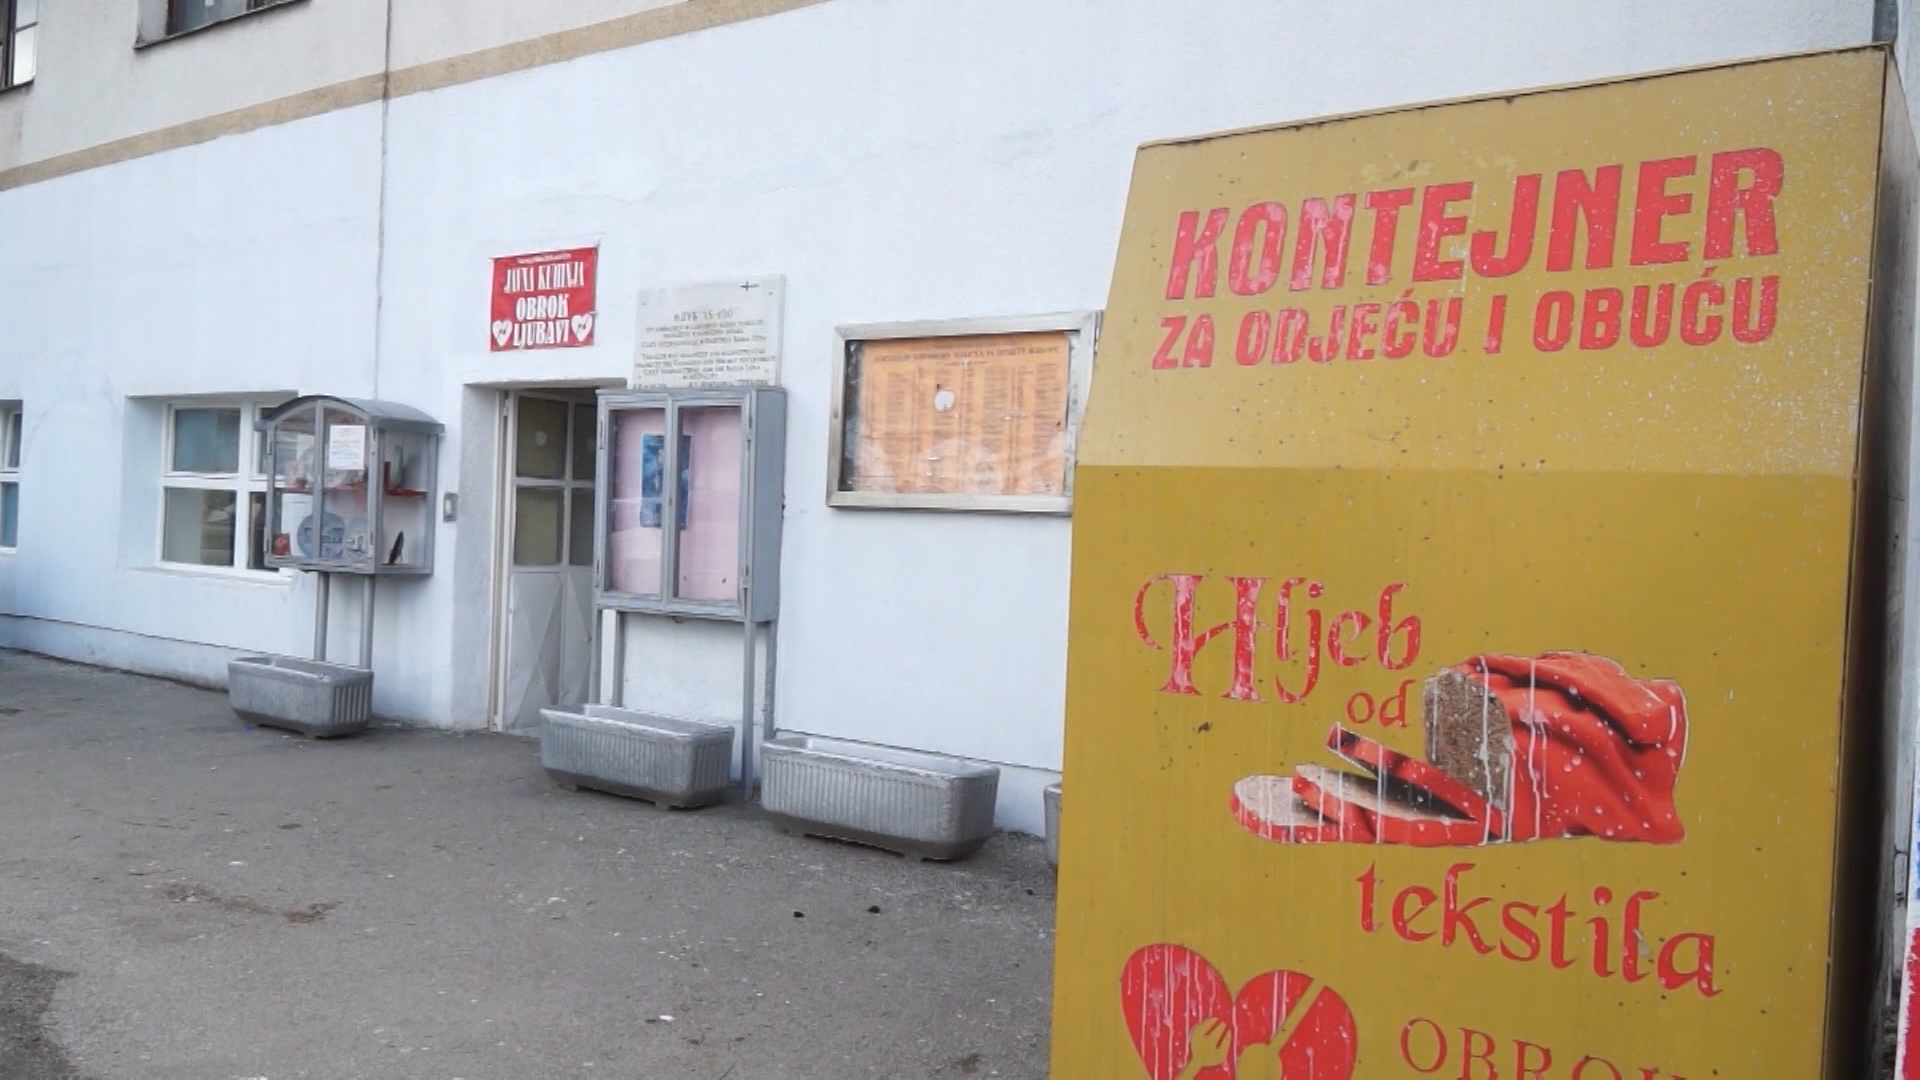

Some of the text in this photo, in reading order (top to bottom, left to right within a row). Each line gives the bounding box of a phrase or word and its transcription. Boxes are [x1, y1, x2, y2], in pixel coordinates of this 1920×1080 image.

[1166, 147, 1785, 299] KONTEJNER
[512, 319, 570, 350] LJUBAVI
[515, 293, 570, 322] OBROK
[1152, 265, 1780, 369] ZA ODJEĆU I OBUĆU
[1134, 573, 1422, 704] Hljeb
[1346, 678, 1416, 728] od
[1356, 861, 1724, 998] tekstila
